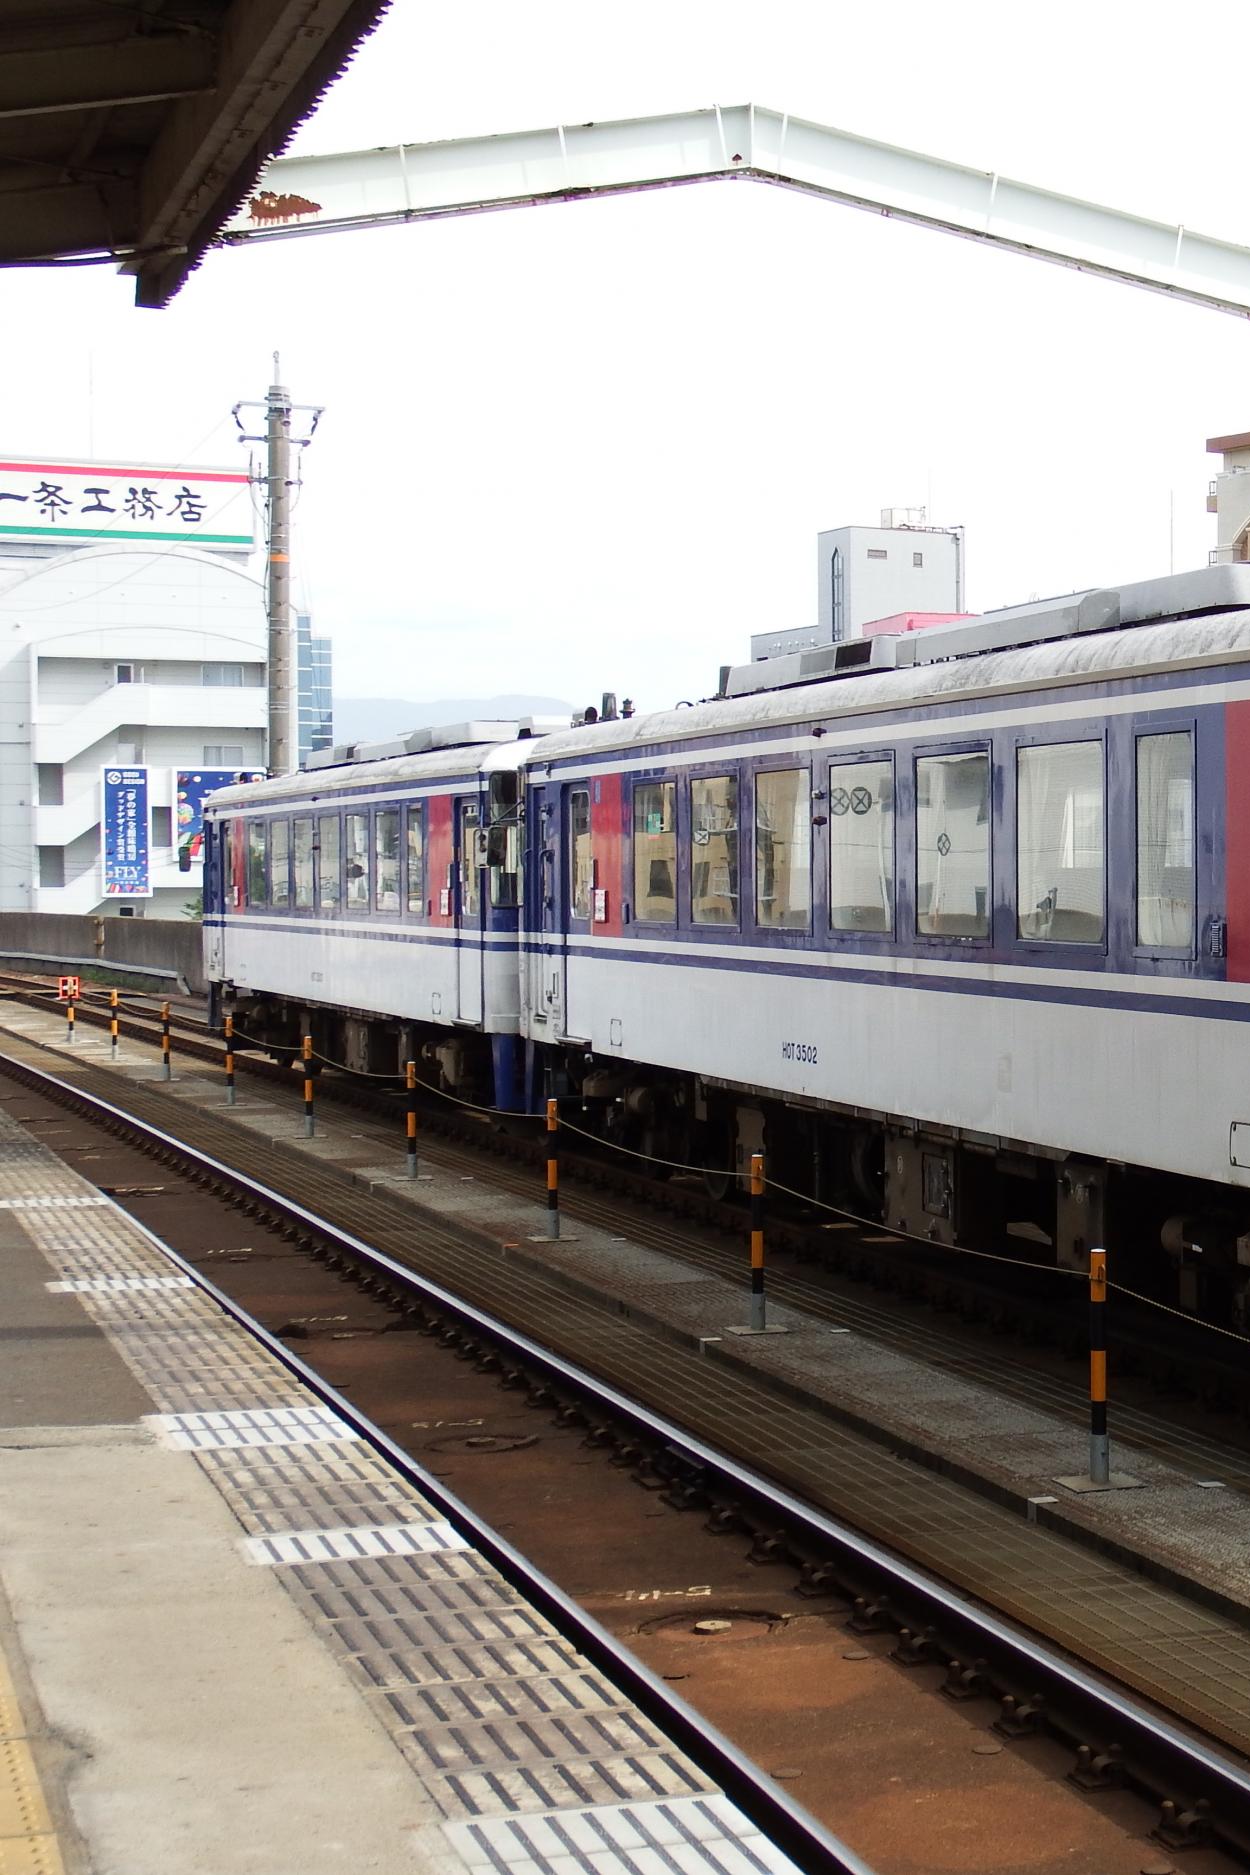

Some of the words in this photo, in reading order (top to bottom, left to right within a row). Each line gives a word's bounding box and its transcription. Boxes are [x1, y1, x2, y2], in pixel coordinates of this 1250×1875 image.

[0, 481, 207, 522] 一条工務店
[114, 866, 141, 879] FLY
